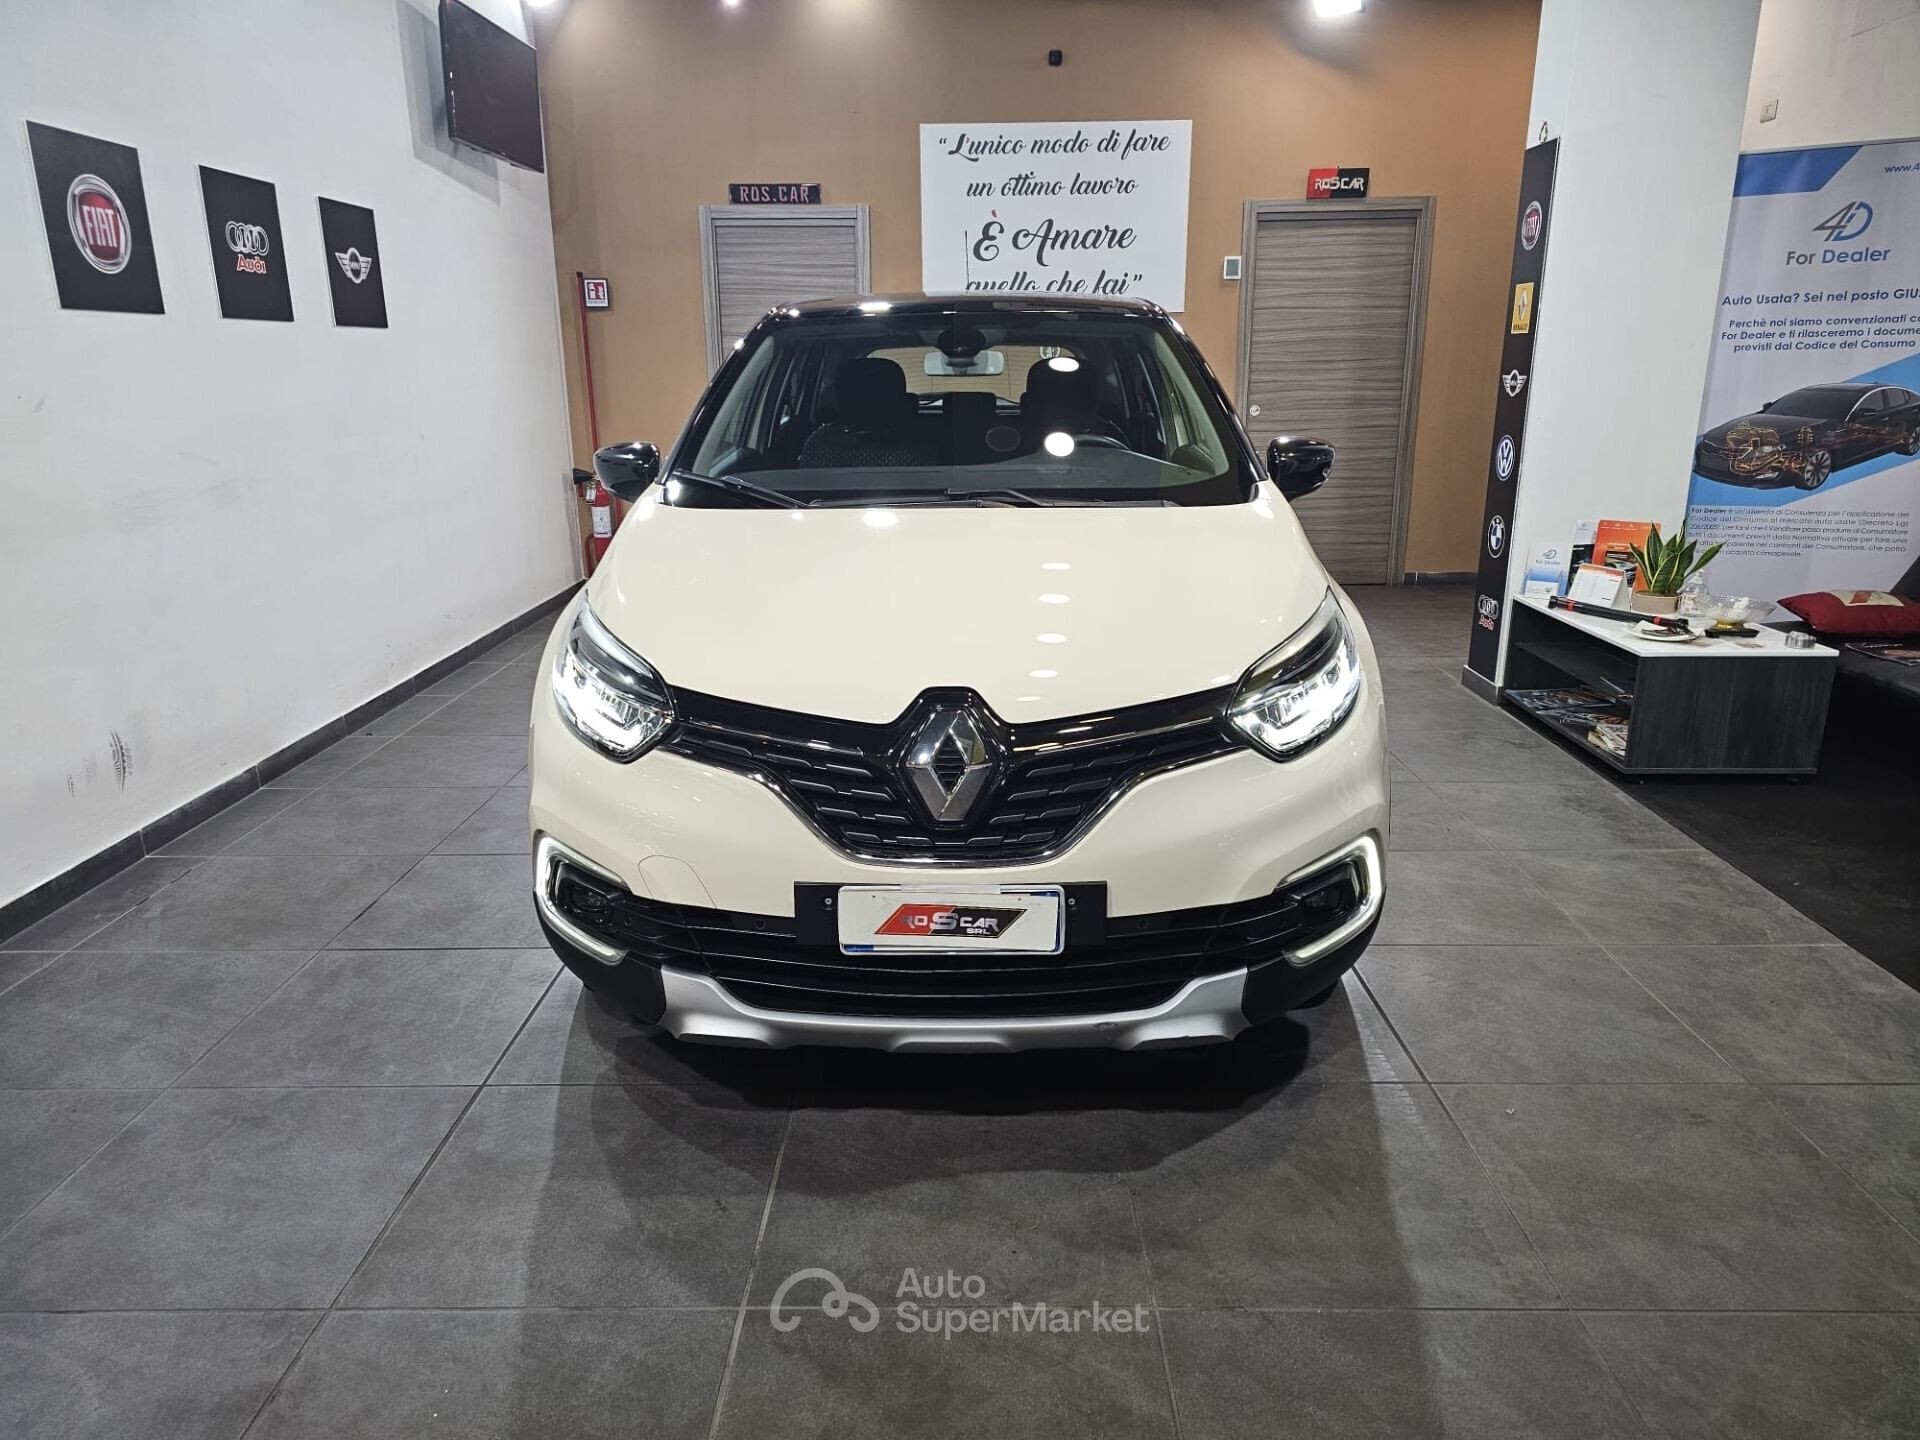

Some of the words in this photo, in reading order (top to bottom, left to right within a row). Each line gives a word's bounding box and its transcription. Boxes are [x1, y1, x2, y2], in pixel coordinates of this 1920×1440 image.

[1030, 130, 1093, 155] modo
[1097, 130, 1120, 153] di
[1120, 128, 1171, 160] fare
[966, 181, 995, 197] un
[1000, 171, 1065, 197] ottimo
[1069, 172, 1139, 196] lavoro
[1314, 177, 1364, 191] ROSCAR
[740, 186, 809, 202] ROS.CAR
[82, 205, 119, 248] FIAT
[973, 208, 1005, 262] È
[1012, 218, 1137, 266] Amare
[237, 254, 266, 274] Audi
[1786, 251, 1816, 265] For
[1822, 247, 1890, 264] Dealer
[1048, 270, 1088, 293] che
[1722, 296, 1751, 306] Auto
[1756, 294, 1800, 304] Usata?
[1804, 292, 1822, 302] Sei
[1826, 292, 1846, 302] nel
[1852, 290, 1888, 302] posto
[1894, 288, 1920, 300] GIU
[1770, 318, 1786, 326] noi
[1790, 318, 1822, 326] siamo
[1826, 314, 1907, 326] convenzionati
[1722, 332, 1737, 340] For
[1740, 330, 1775, 340] Dealer
[1790, 330, 1795, 338] ti
[1798, 327, 1864, 338] rilasceremo
[1734, 342, 1772, 353] previsti
[1775, 342, 1792, 350] dal
[1796, 342, 1836, 350] Codice
[1840, 340, 1857, 350] del
[1861, 340, 1916, 349] Consumo
